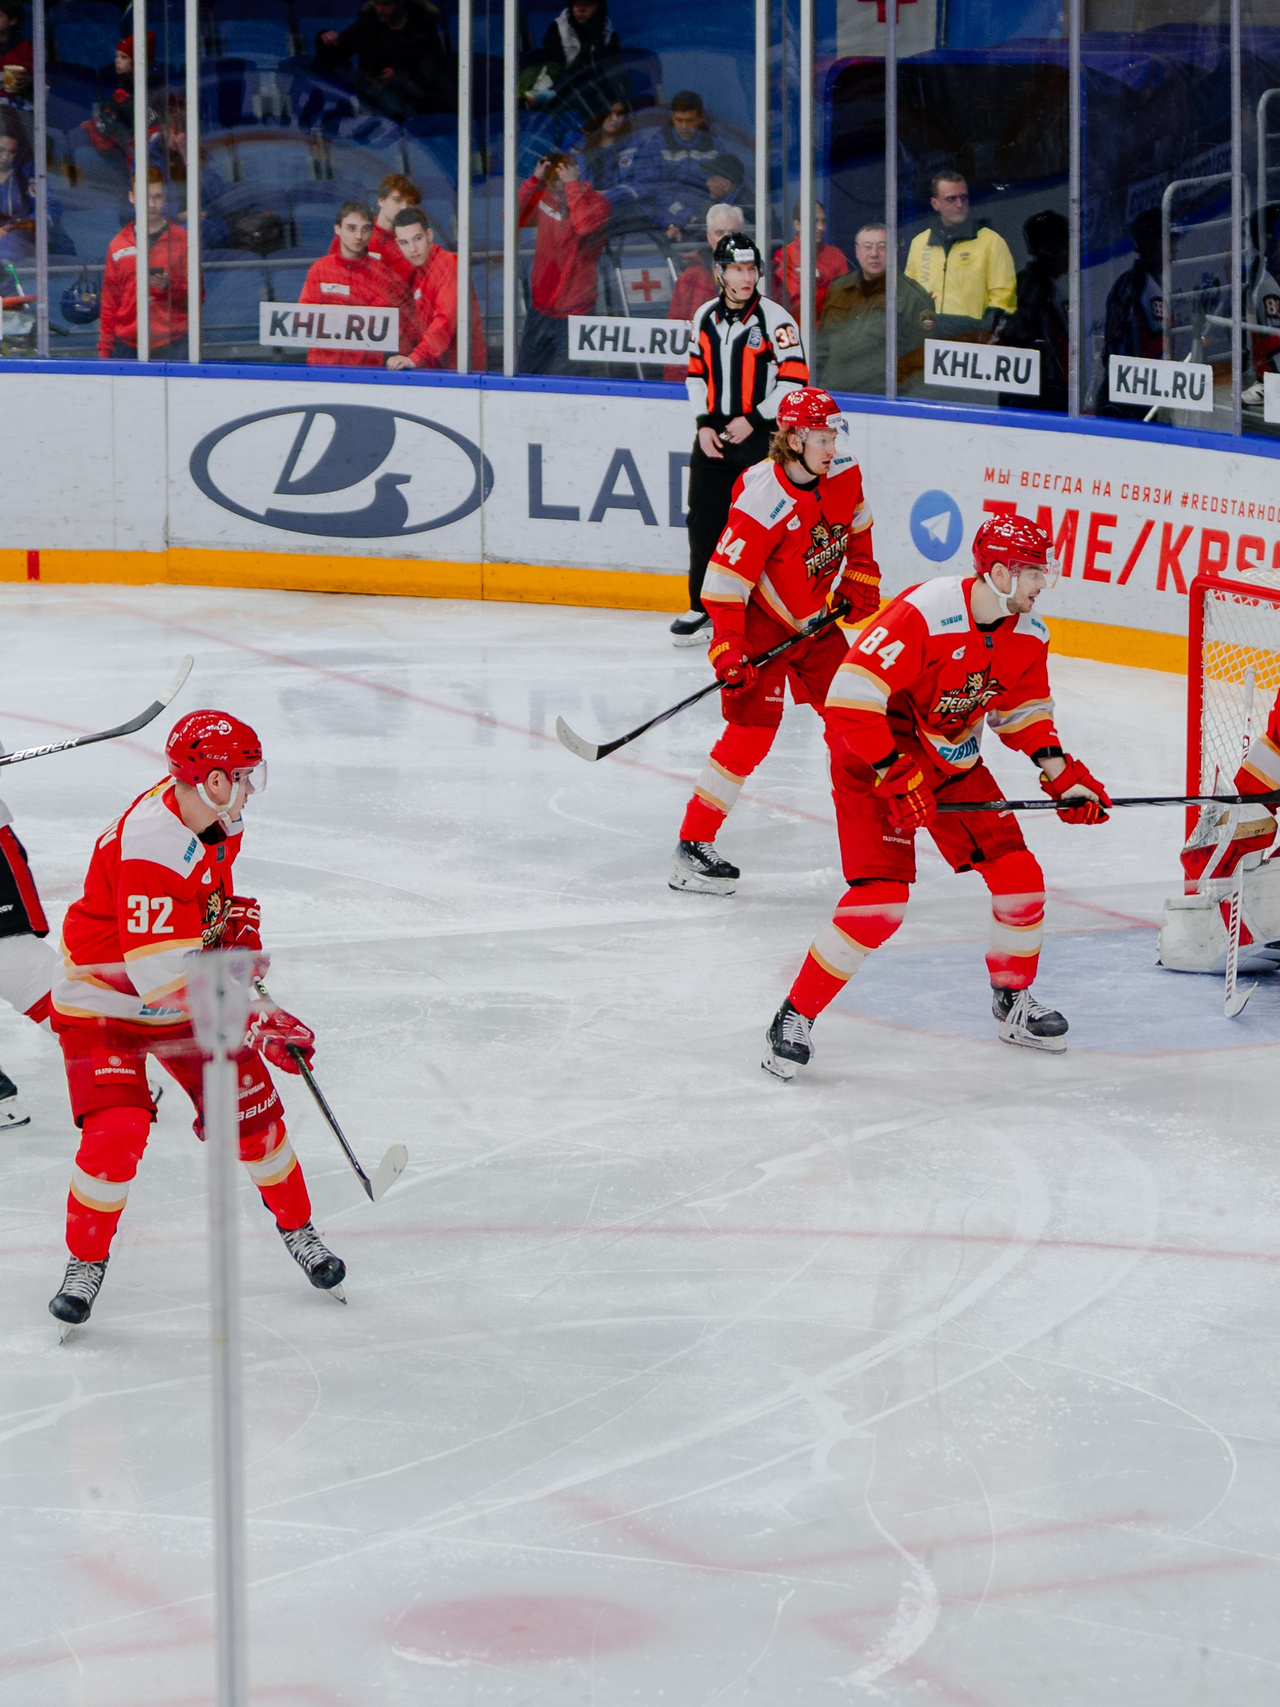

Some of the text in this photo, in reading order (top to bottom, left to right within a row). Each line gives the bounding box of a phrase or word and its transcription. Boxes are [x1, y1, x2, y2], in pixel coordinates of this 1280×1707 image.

[269, 310, 390, 342] KHL.RU
[578, 324, 690, 355] KHL.RU
[774, 326, 799, 347] 38
[932, 349, 1032, 384] KHL.RU
[1116, 364, 1206, 401] KHL.RU
[528, 443, 689, 528] LA
[984, 467, 1010, 485] МЫ
[1020, 471, 1082, 494] ВСЕГДА
[1092, 480, 1111, 497] НА
[1121, 484, 1172, 505] СВЯЗИ
[716, 526, 746, 566] 94
[842, 568, 880, 587] WARRIO
[940, 614, 963, 627] SIBUR
[858, 626, 905, 670] 84
[938, 736, 979, 762] SIBUR
[126, 895, 174, 934] 32
[228, 906, 260, 920] CC
